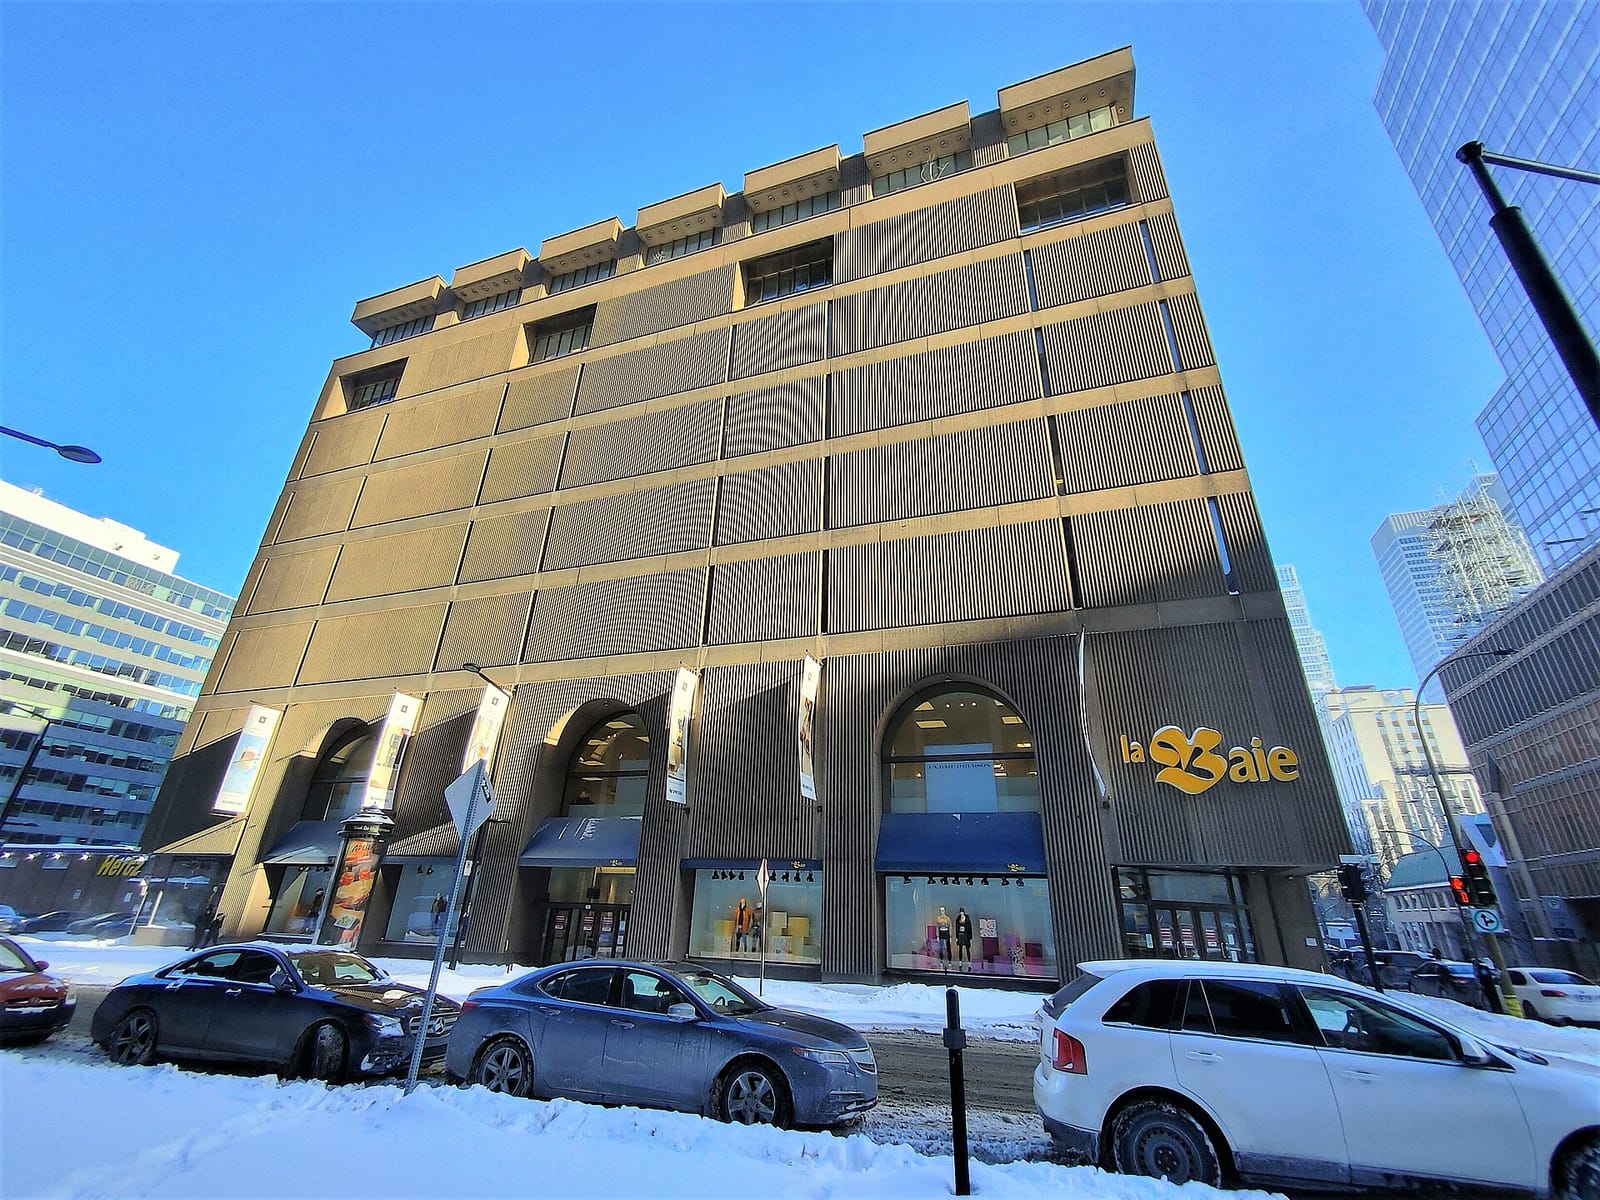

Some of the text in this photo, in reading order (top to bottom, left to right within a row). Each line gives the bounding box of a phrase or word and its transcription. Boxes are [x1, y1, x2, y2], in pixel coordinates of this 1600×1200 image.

[1120, 725, 1300, 795] la Baie
[97, 855, 144, 876] Hertz
